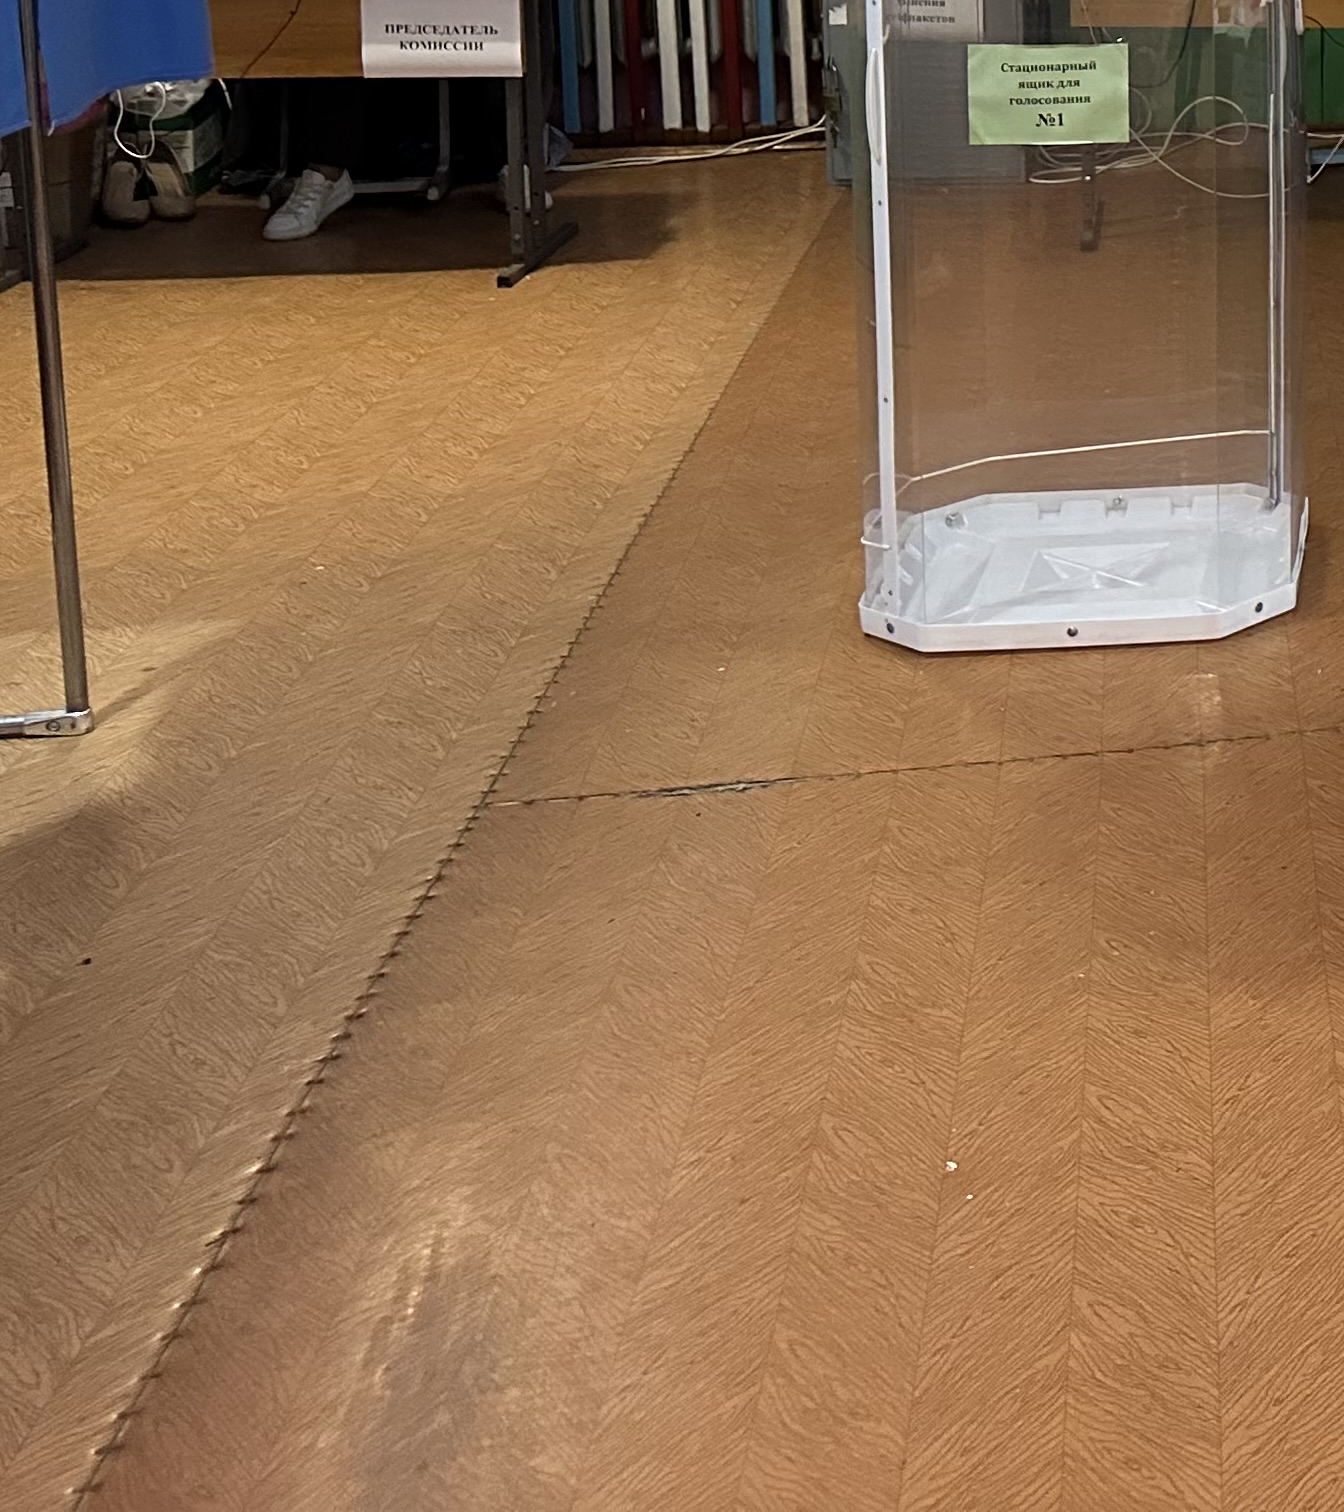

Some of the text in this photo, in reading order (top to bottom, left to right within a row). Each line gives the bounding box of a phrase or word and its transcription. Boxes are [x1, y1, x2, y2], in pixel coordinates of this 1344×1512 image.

[384, 24, 499, 36] ПРЕДСЕДАТЕЛЬ
[399, 40, 484, 51] КОМИССИИ
[1000, 60, 1097, 74] Стационарный
[1018, 79, 1080, 90] ящик для
[1009, 95, 1091, 106] голосования
[1035, 113, 1064, 128] №1
